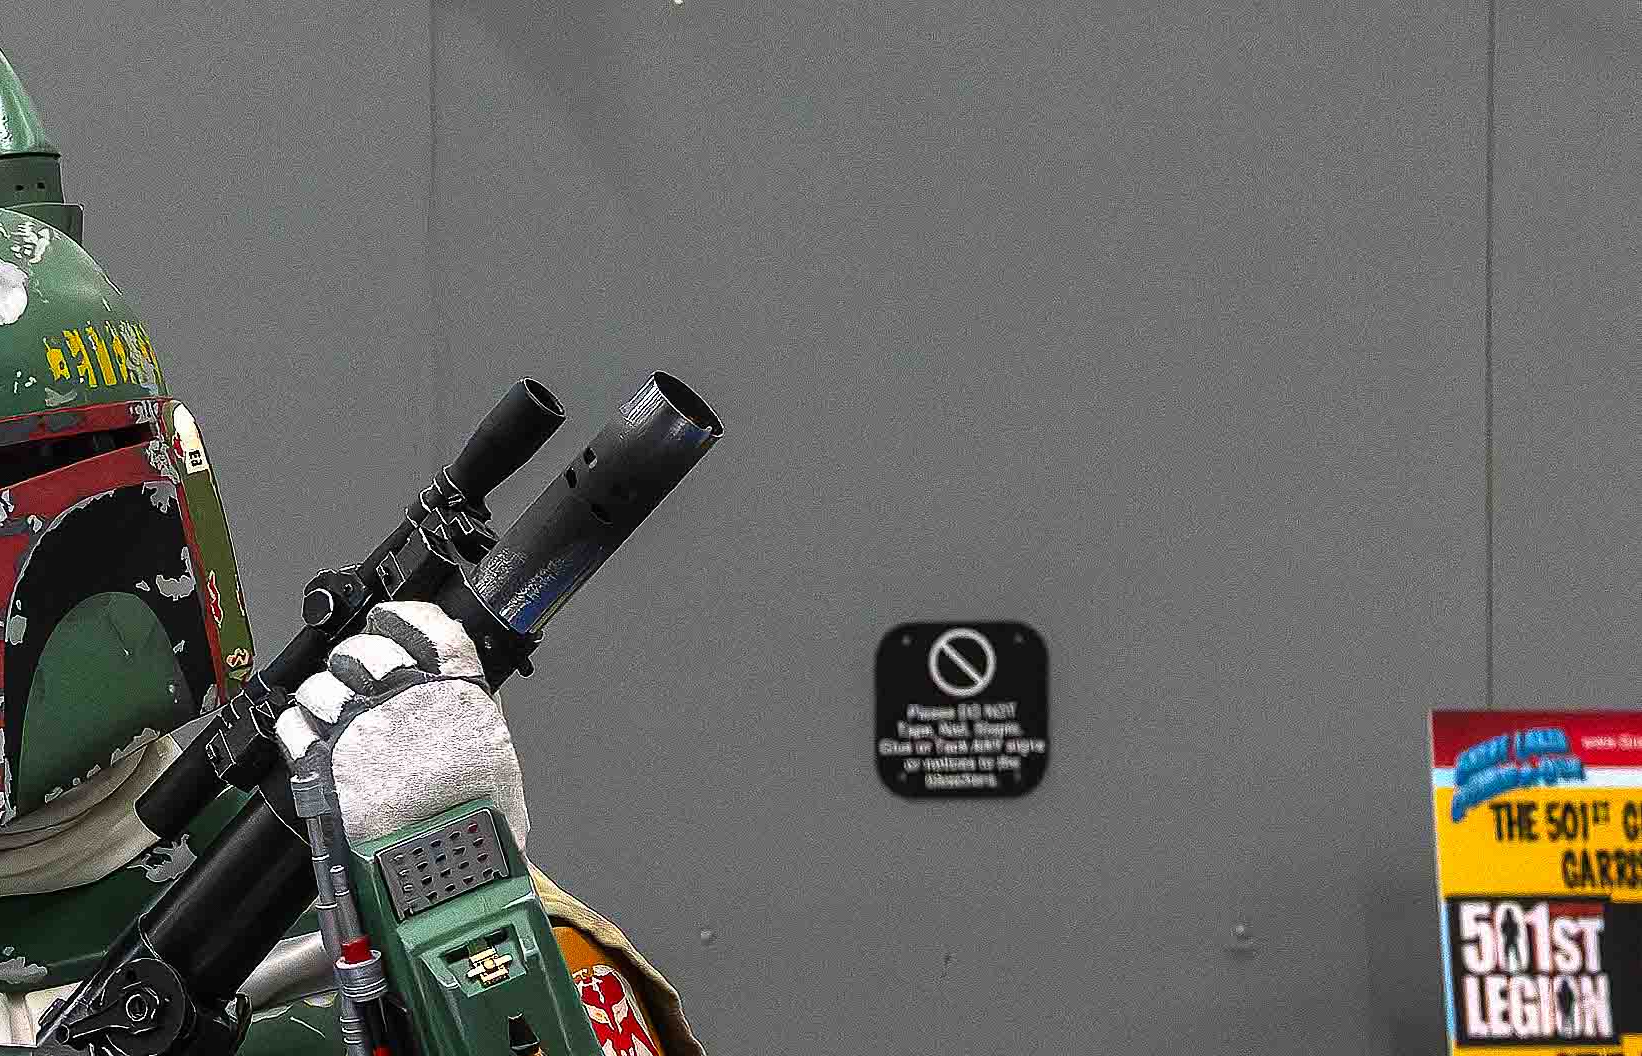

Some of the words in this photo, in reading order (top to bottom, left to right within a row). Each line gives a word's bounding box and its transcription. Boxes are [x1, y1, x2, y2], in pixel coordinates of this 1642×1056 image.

[1491, 801, 1539, 842] THE
[1460, 902, 1605, 974] 501ST
[1463, 974, 1613, 1040] LEGION
